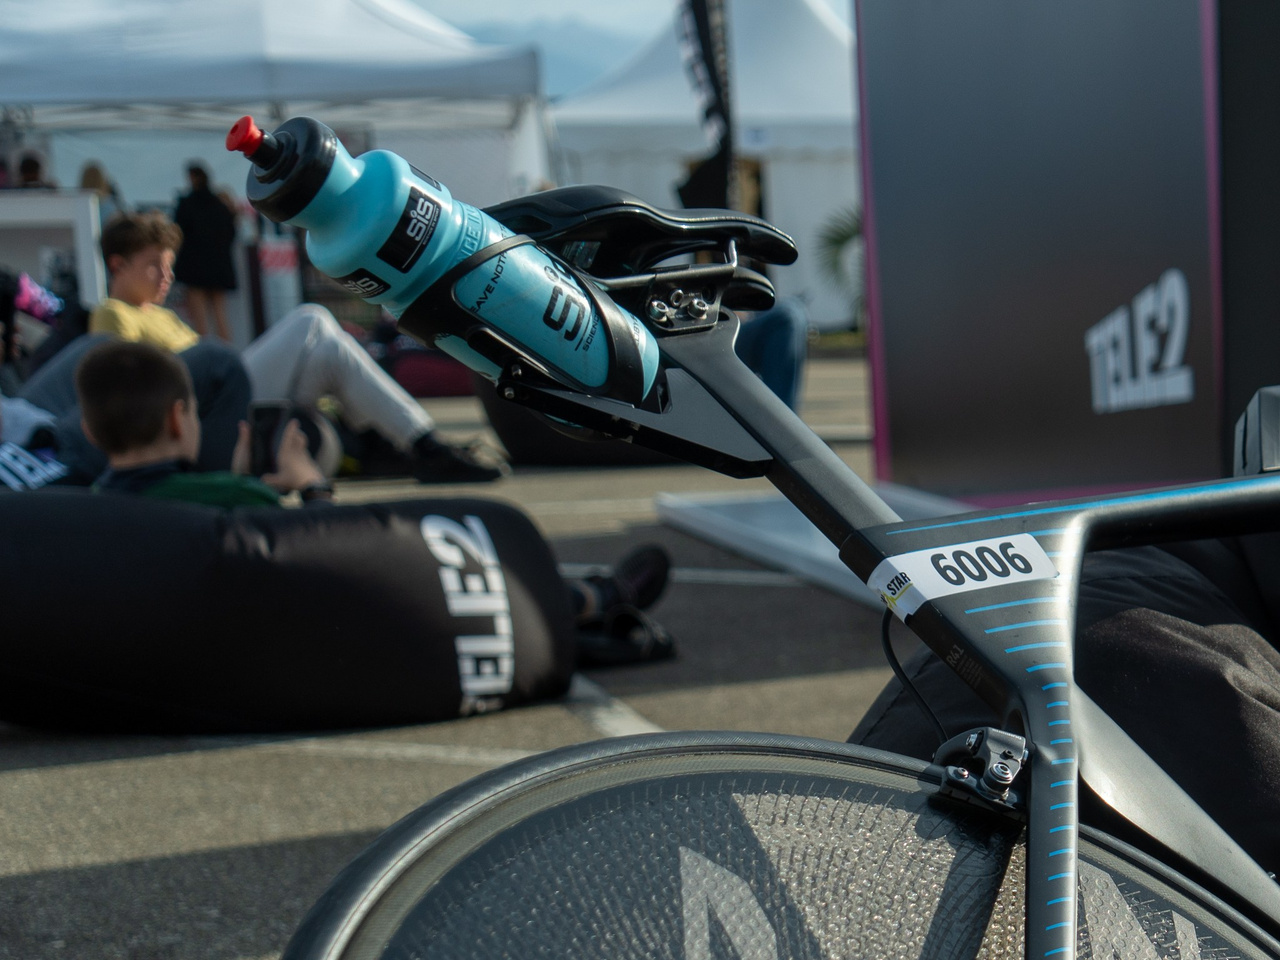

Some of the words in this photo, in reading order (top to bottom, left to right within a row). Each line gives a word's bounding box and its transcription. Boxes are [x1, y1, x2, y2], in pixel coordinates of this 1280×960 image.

[406, 197, 434, 242] SiS
[470, 284, 496, 314] EAVE
[582, 314, 601, 352] SCIENC
[930, 541, 1033, 587] 6006
[886, 571, 912, 596] STAR
